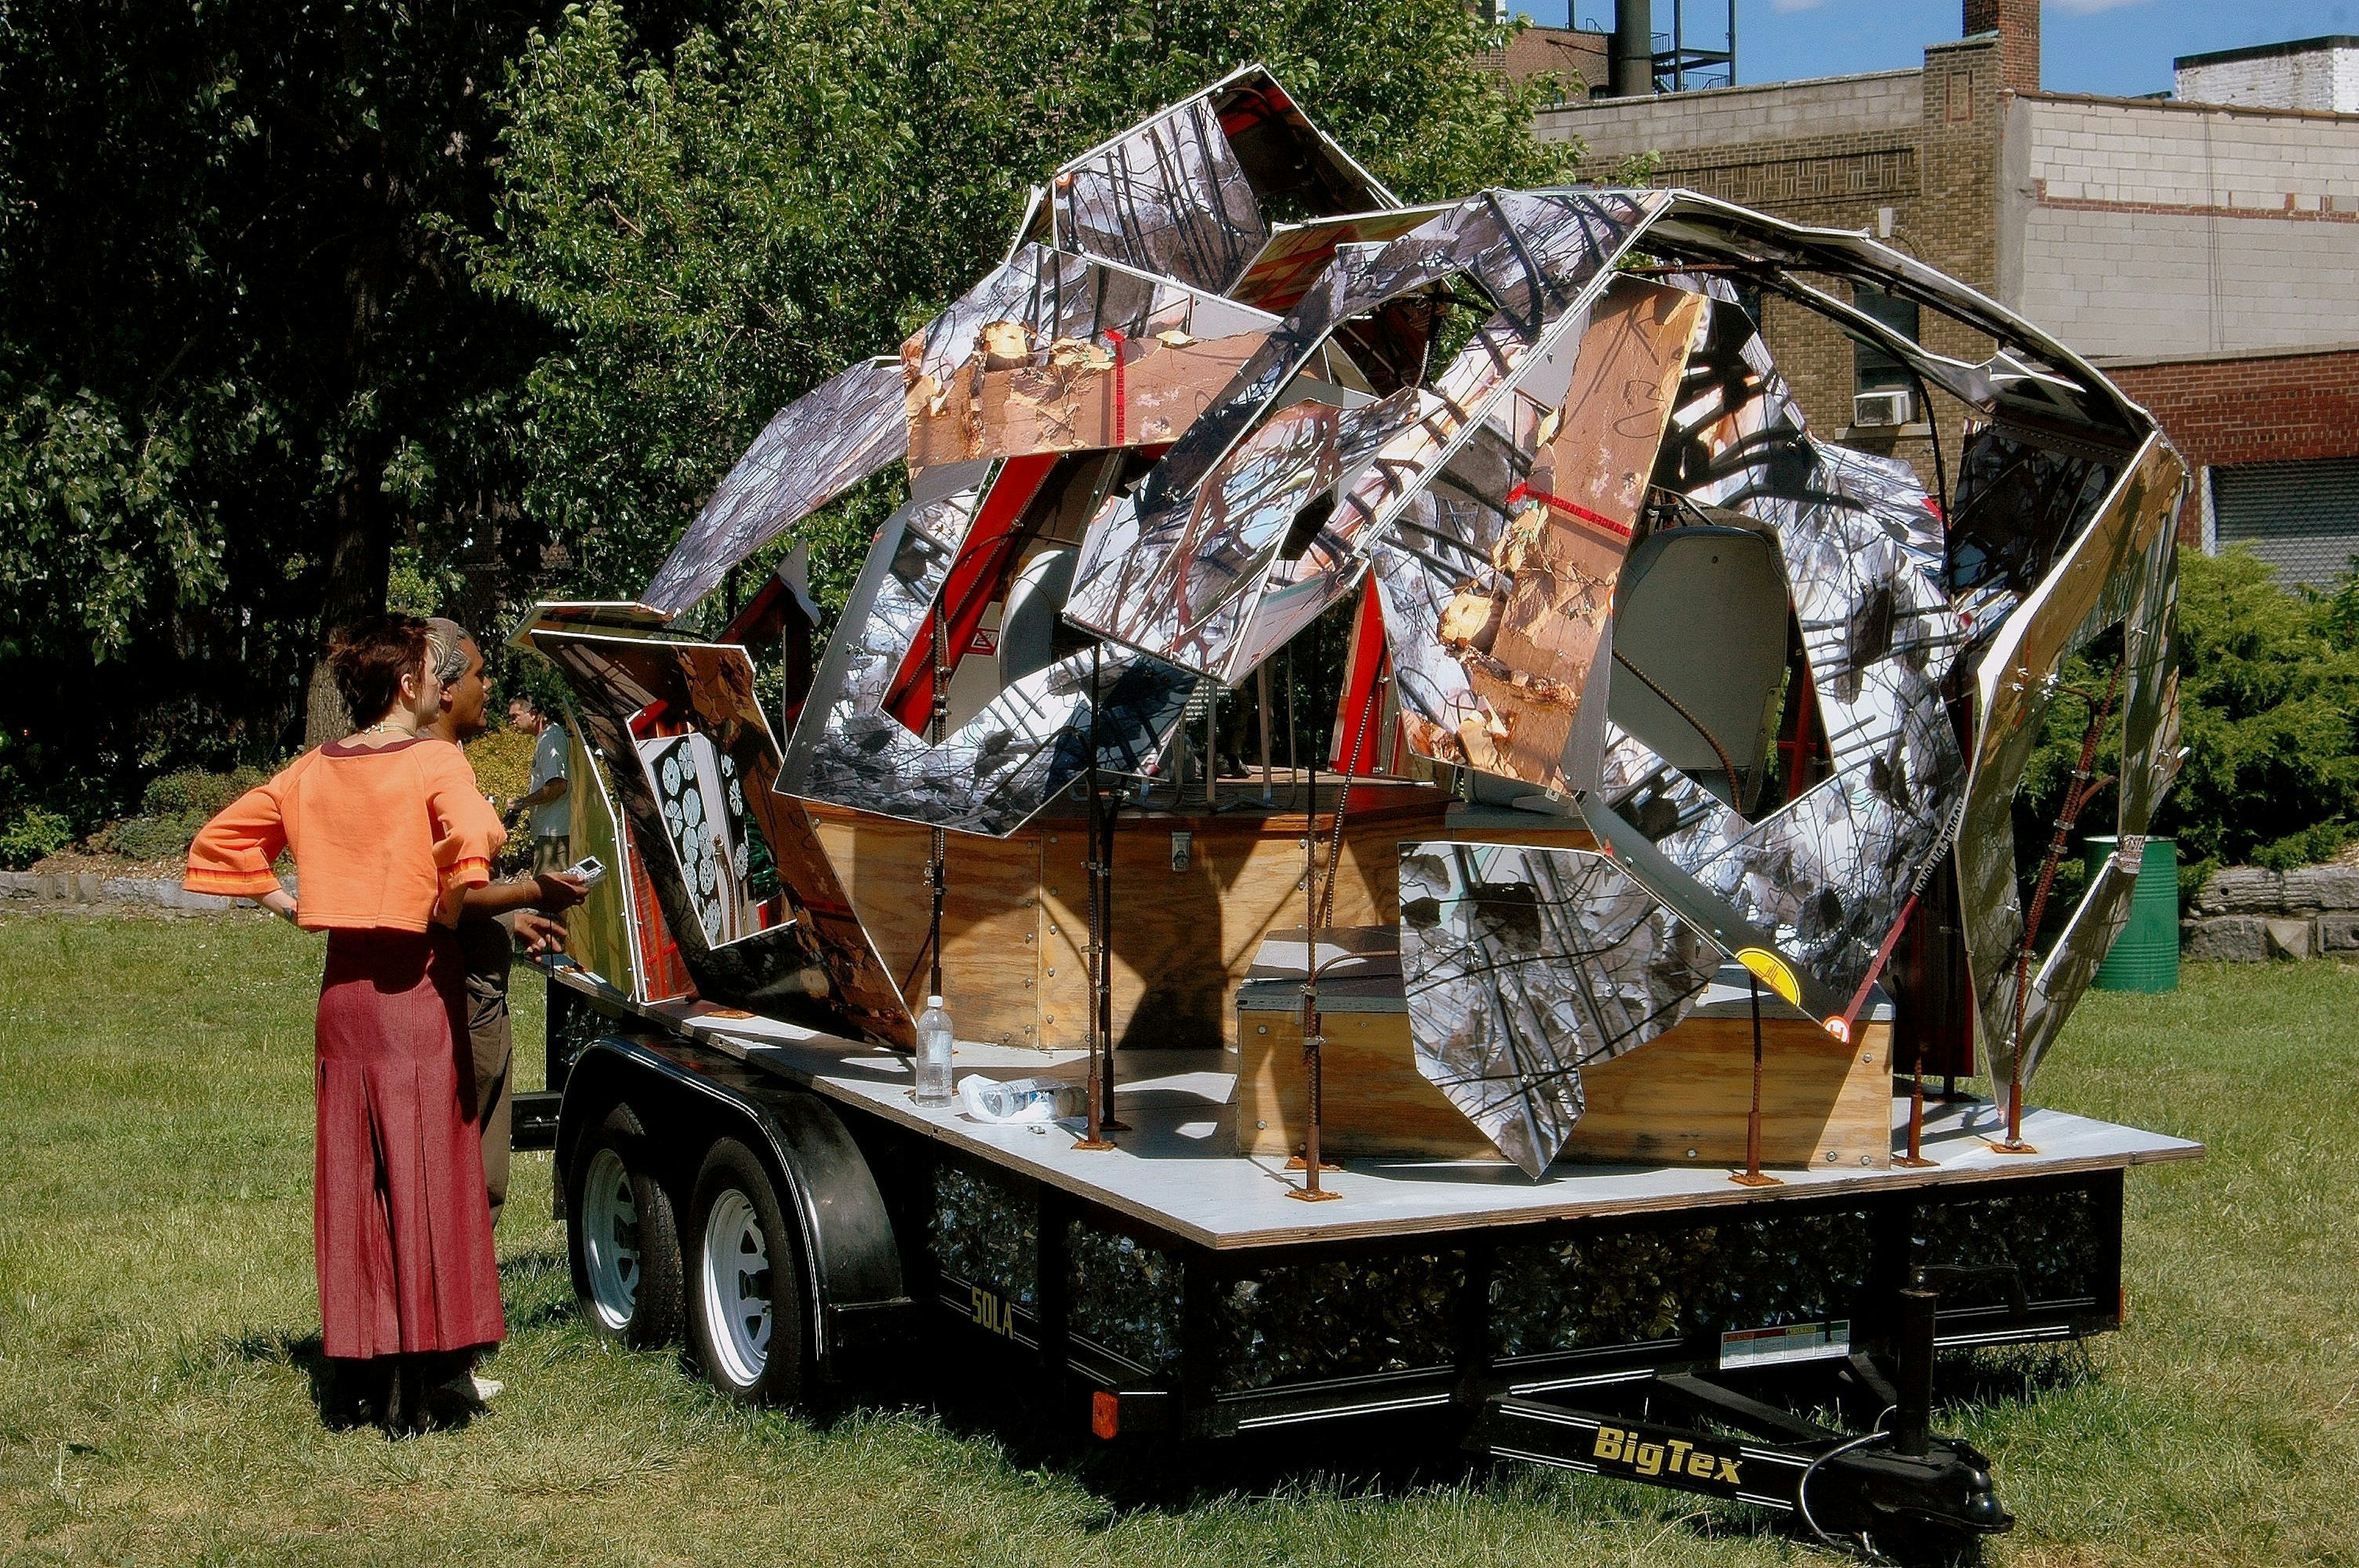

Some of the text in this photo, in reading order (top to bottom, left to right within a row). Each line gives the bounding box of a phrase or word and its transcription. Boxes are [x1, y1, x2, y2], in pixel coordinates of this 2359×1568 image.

[1914, 846, 1947, 894] DIVISION
[972, 1286, 1013, 1340] 50LA
[1594, 1426, 1743, 1484] BigTex
